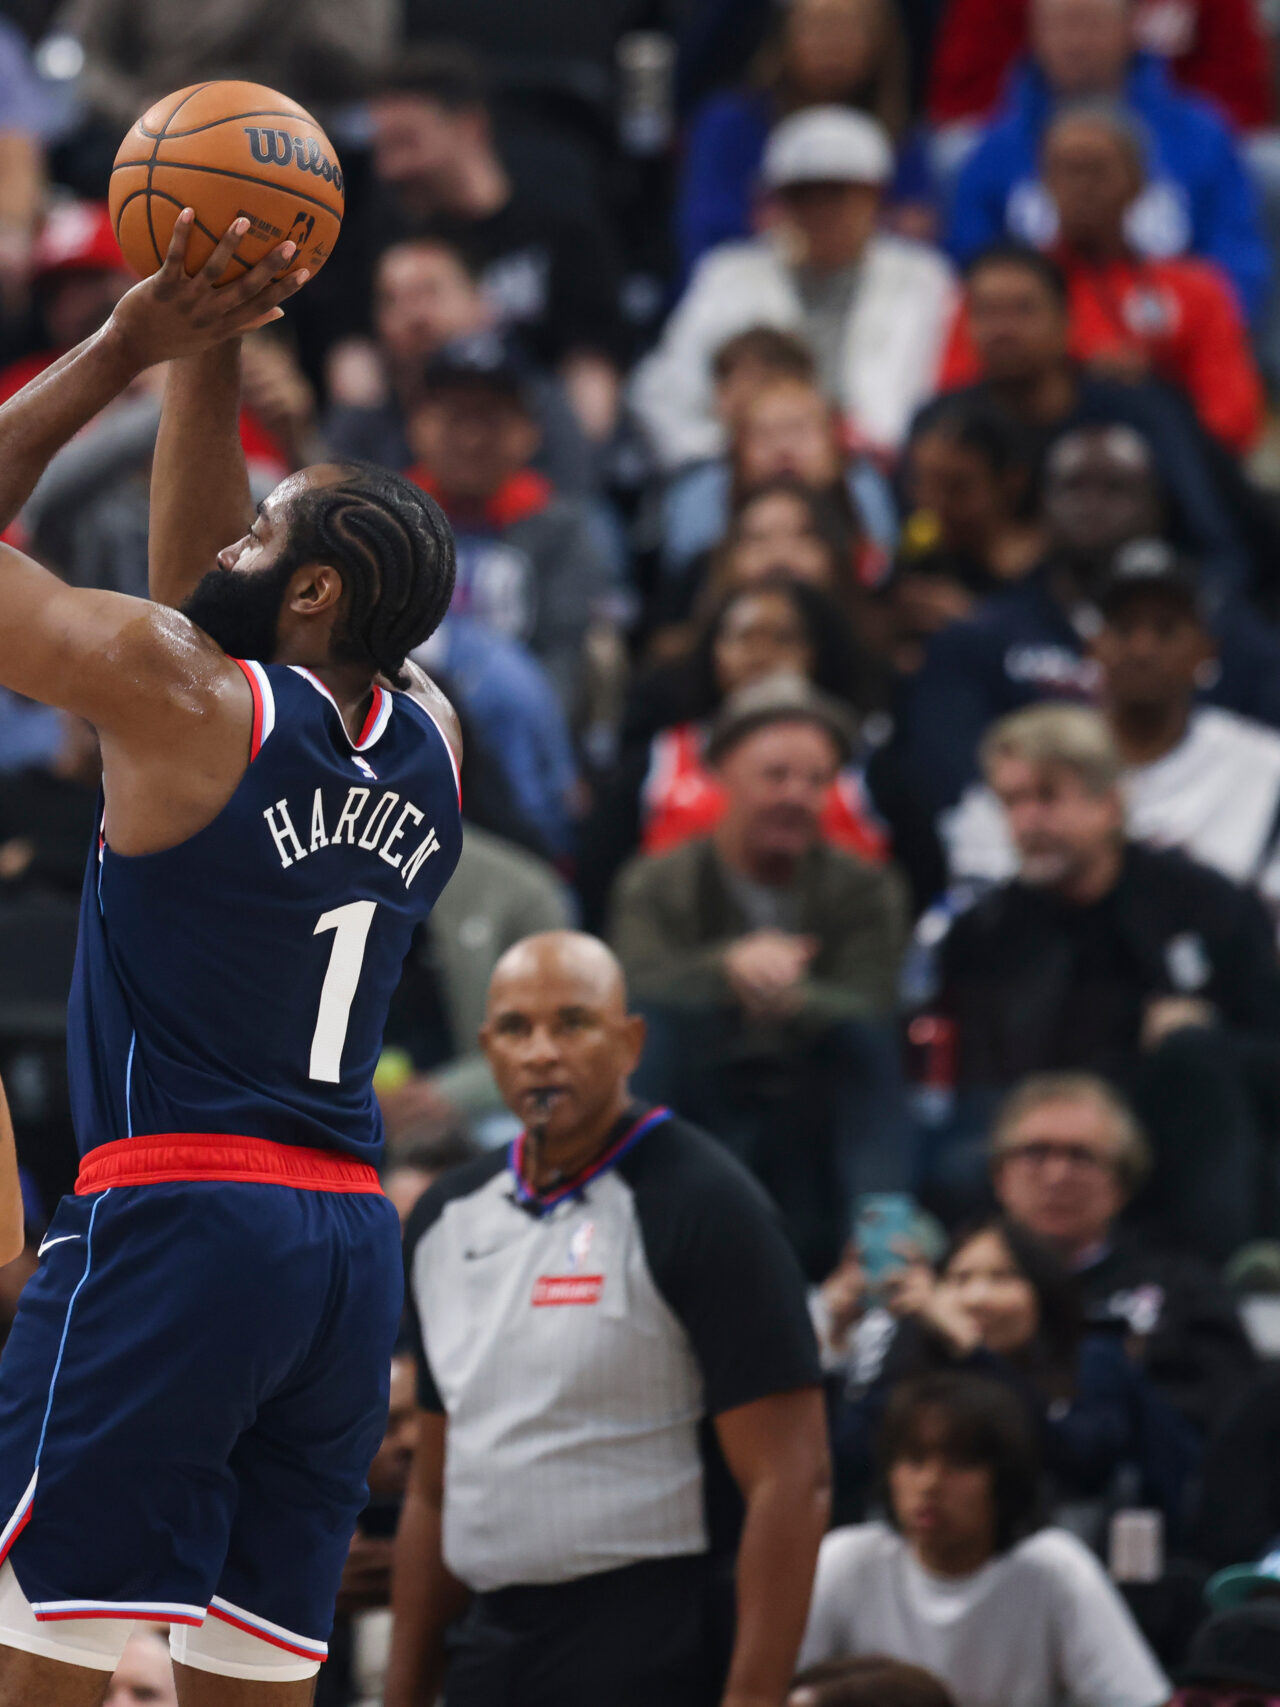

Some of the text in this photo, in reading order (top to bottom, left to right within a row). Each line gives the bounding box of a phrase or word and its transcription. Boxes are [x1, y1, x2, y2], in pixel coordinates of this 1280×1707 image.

[243, 126, 344, 198] Wilso
[263, 786, 440, 889] HARDEN
[309, 900, 377, 1084] 1
